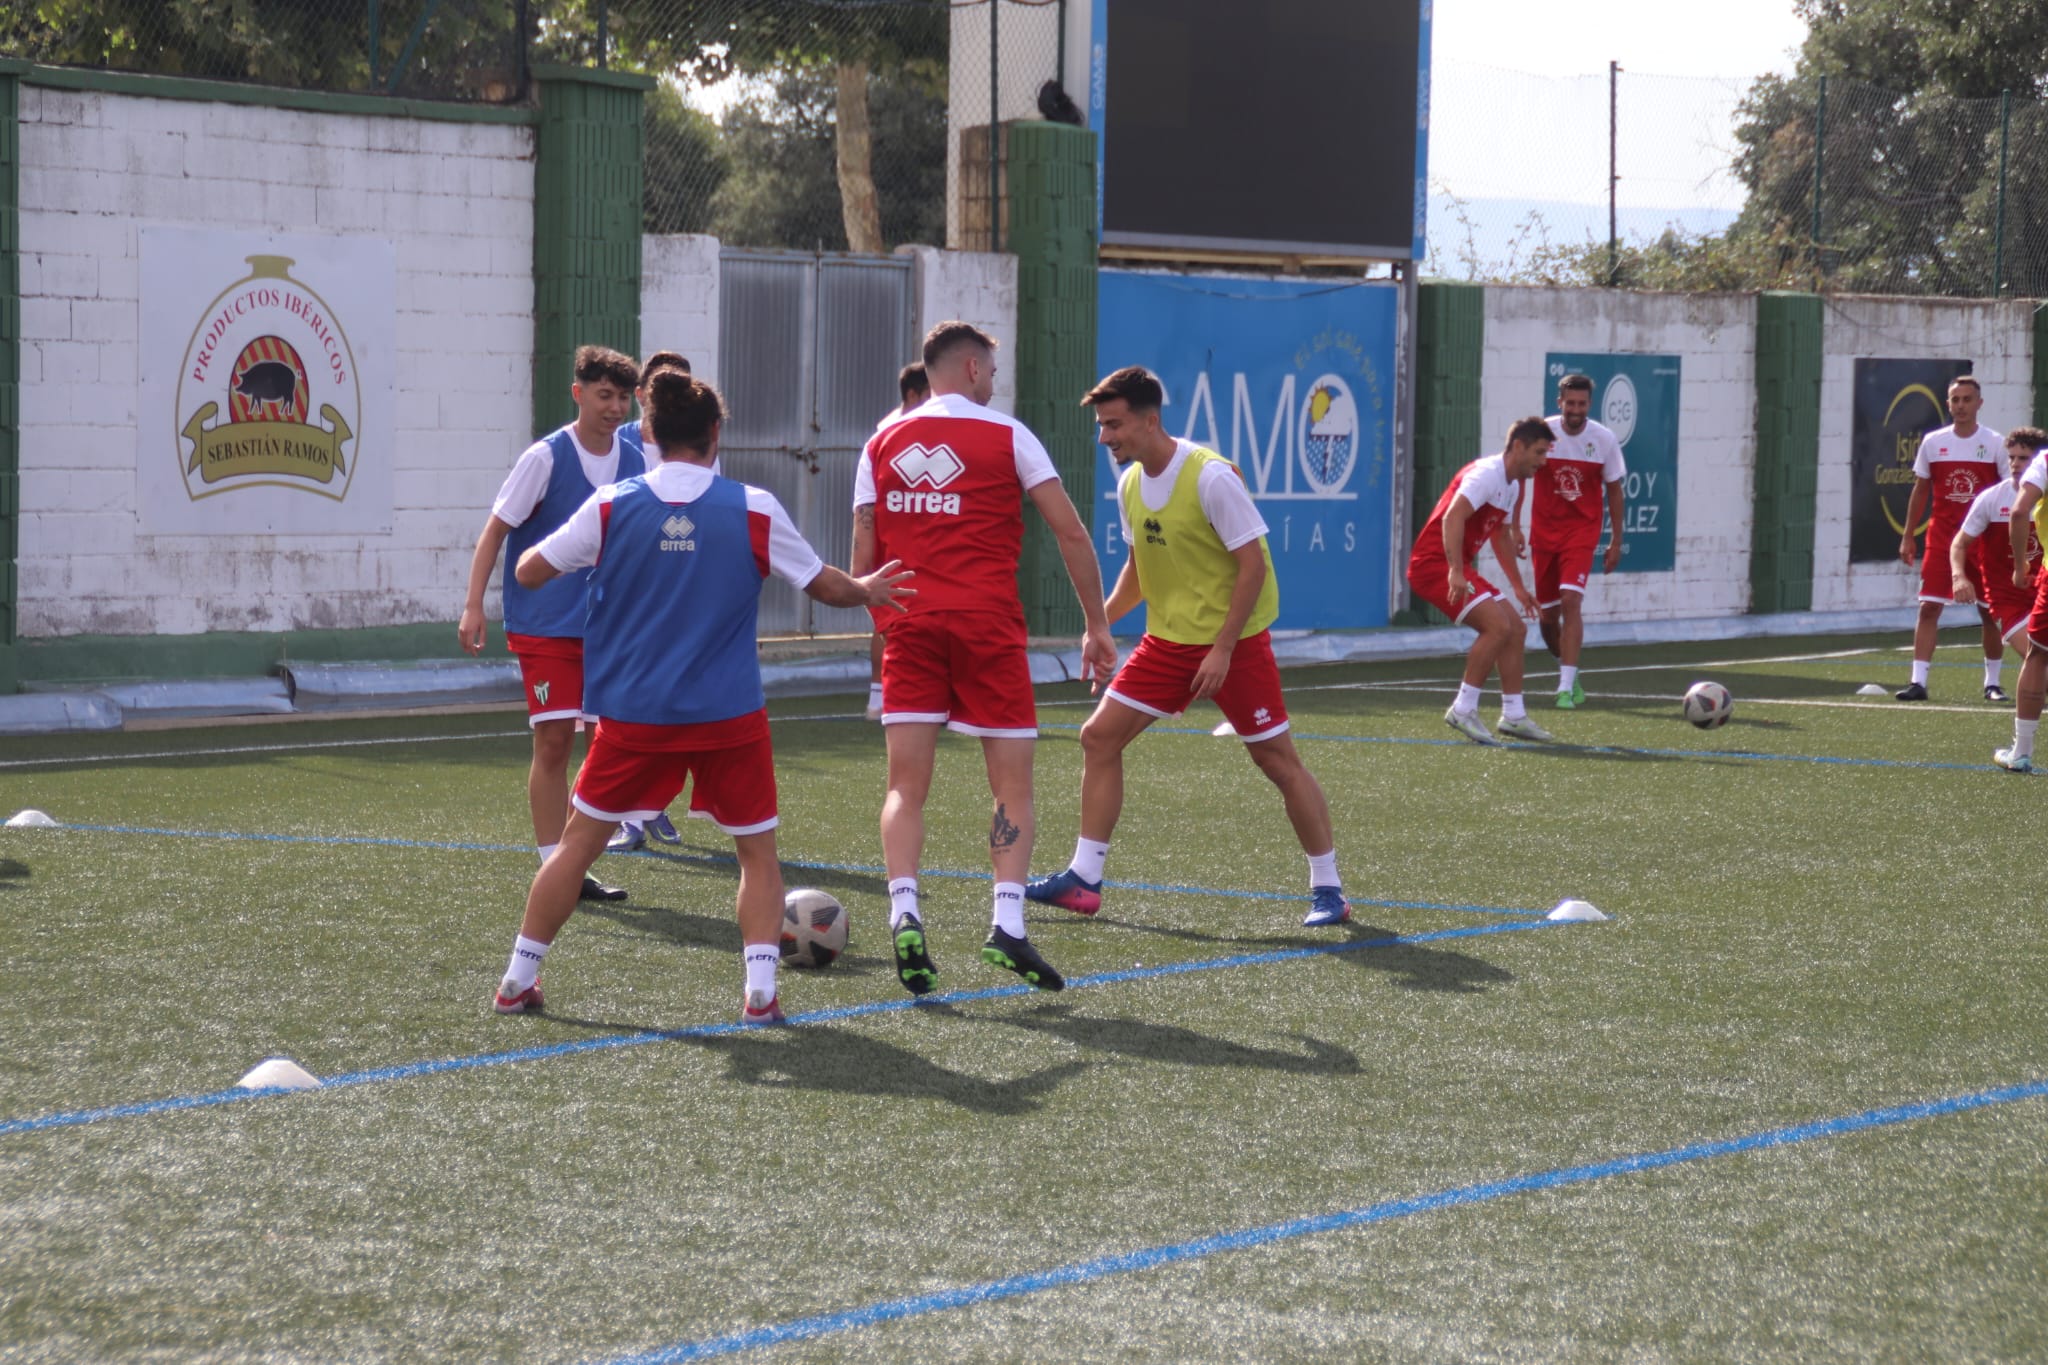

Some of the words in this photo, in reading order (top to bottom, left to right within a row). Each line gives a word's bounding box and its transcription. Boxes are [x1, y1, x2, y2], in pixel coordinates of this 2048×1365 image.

[193, 288, 280, 383] PRODUCTOS
[284, 292, 346, 385] IBÉRICOS
[207, 433, 281, 464] SEBASTIÁN
[283, 438, 329, 466] RAMOS
[1896, 431, 1922, 462] Isid
[1646, 471, 1658, 498] Y
[886, 490, 960, 515] errea
[660, 540, 695, 551] errea
